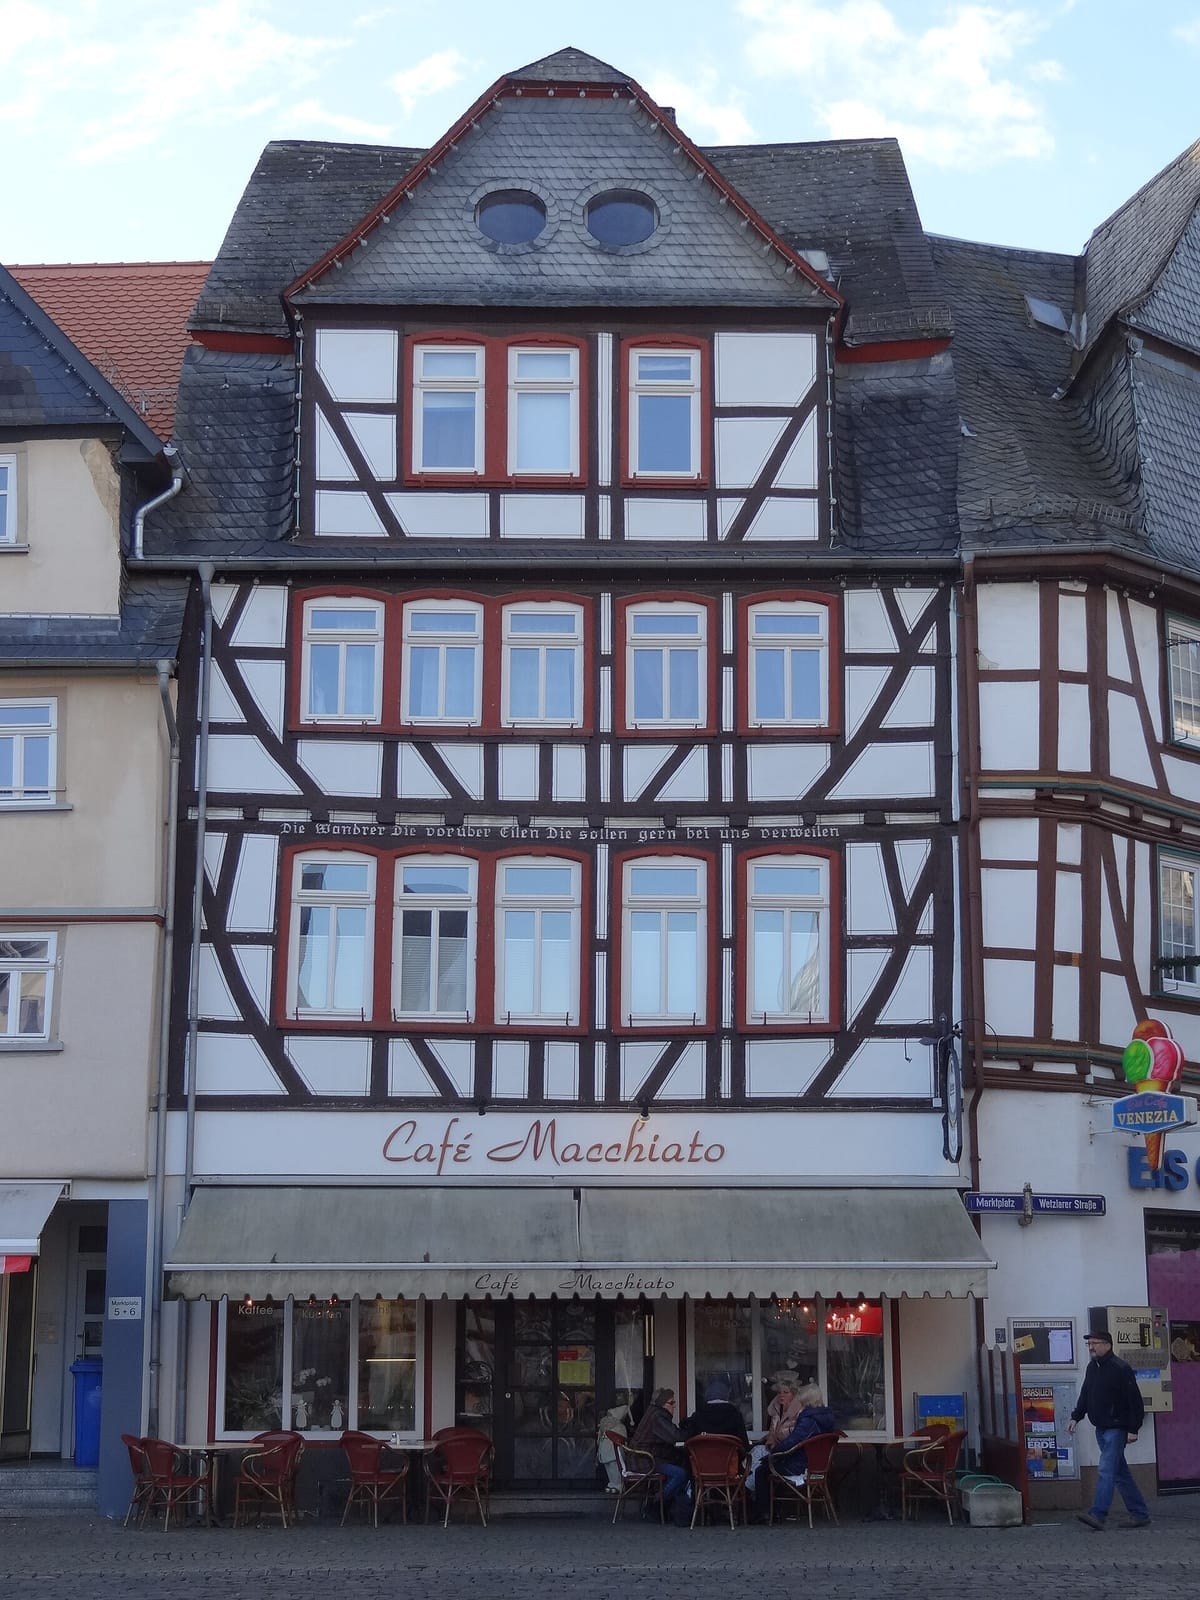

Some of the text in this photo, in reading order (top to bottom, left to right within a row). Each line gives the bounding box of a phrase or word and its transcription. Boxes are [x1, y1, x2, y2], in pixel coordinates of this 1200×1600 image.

[280, 822, 306, 835] Die
[390, 825, 417, 837] Die
[425, 827, 491, 838] vorüber
[500, 827, 540, 839] Eilen
[546, 827, 572, 839] Die
[578, 827, 627, 840] sollen
[638, 829, 676, 843] gern
[686, 826, 710, 840] bei
[719, 828, 750, 840] uns
[760, 825, 840, 840] verweilen
[1117, 1110, 1179, 1125] VENEZIA
[382, 1114, 725, 1175] Café Macchiato
[976, 1197, 1016, 1209] Marktplatz
[1038, 1198, 1097, 1211] Wetzlarer Straße
[474, 1272, 676, 1296] Café Macchiato
[114, 1307, 120, 1316] 5
[129, 1307, 136, 1316] 6
[238, 1305, 274, 1316] Kaffee
[1027, 1441, 1056, 1449] ERDE
